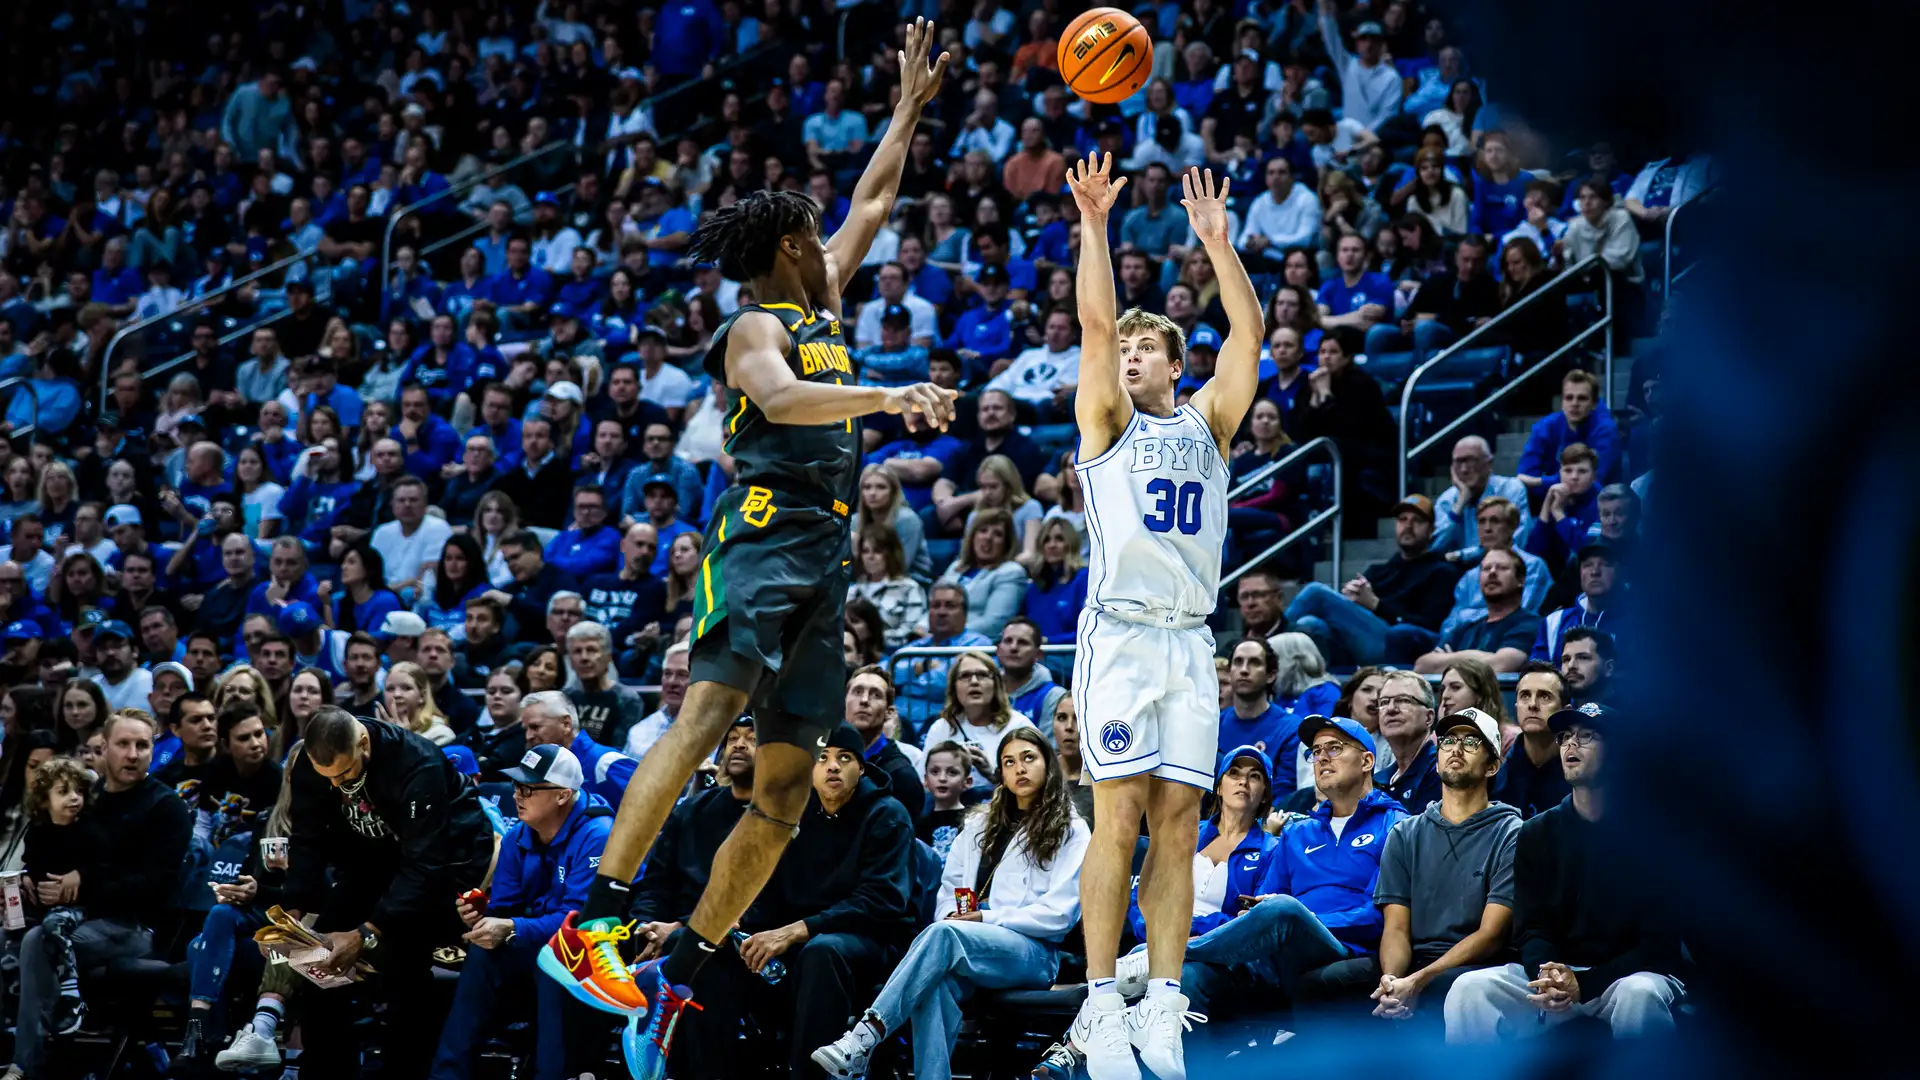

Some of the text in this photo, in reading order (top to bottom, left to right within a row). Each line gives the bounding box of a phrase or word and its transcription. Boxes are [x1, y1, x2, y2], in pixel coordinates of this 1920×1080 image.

[1073, 21, 1118, 61] ELITE
[1130, 437, 1215, 480] BYU
[1143, 477, 1204, 535] 30
[590, 588, 638, 605] BYU
[577, 703, 611, 722] YU
